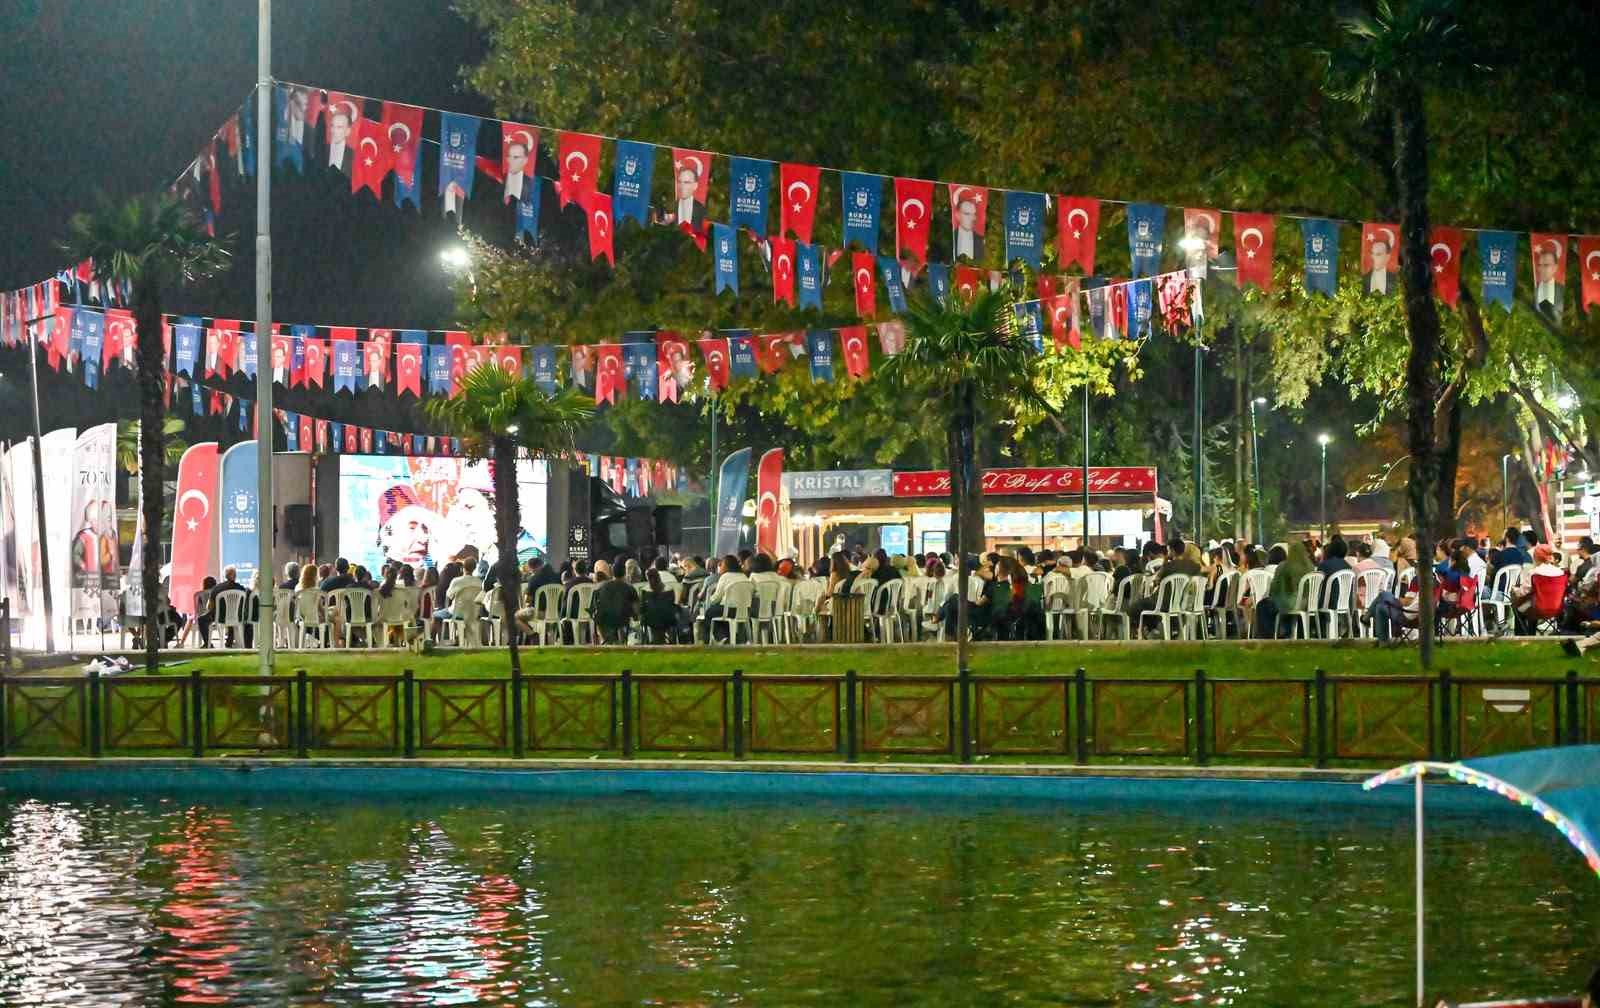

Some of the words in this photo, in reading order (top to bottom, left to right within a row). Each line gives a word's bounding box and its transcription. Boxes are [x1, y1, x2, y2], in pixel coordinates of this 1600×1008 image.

[795, 474, 862, 489] KRİSTAL
[1004, 473, 1054, 492] Büfe
[1056, 472, 1073, 487] &
